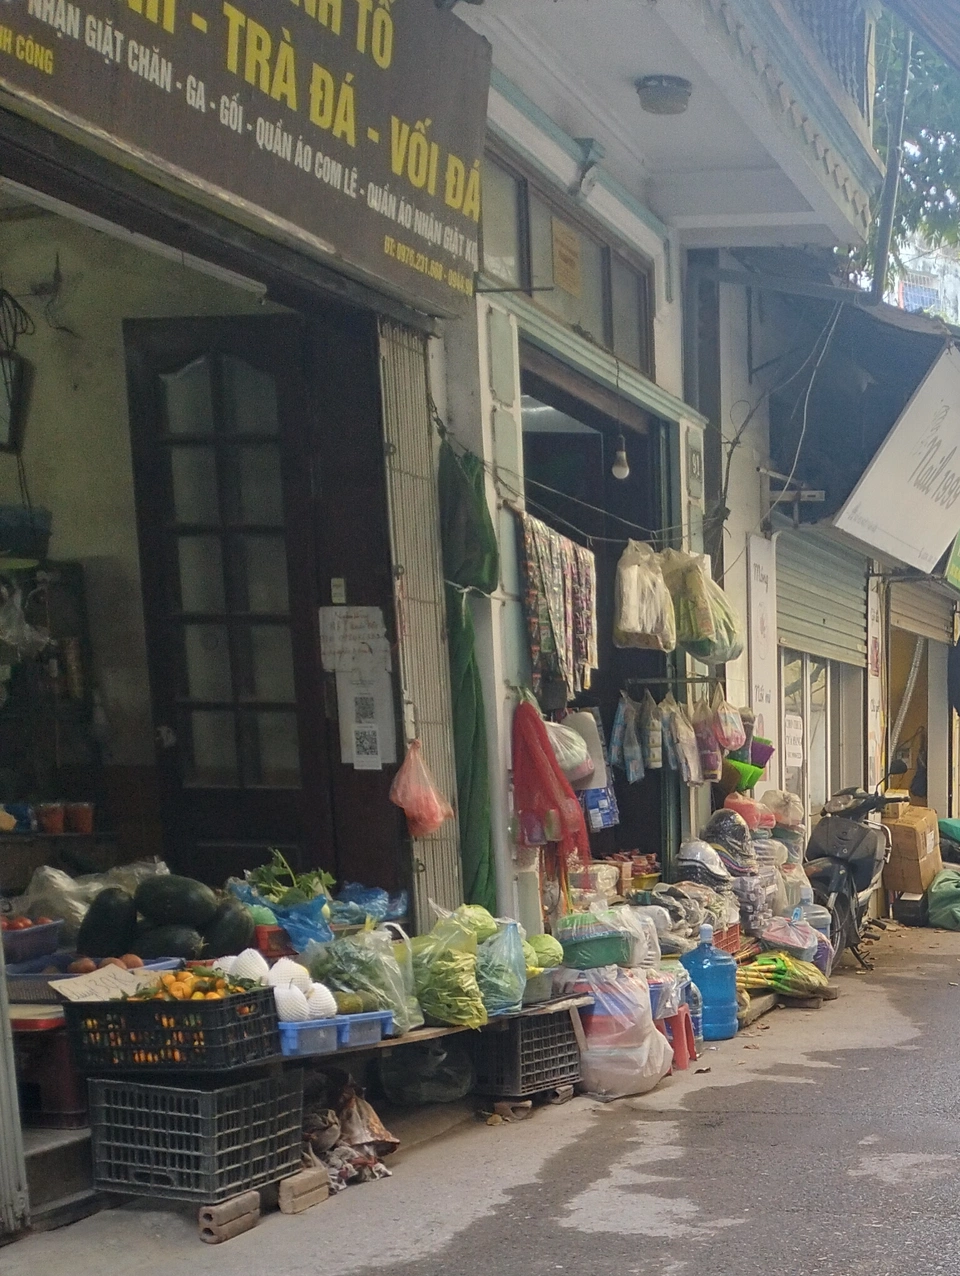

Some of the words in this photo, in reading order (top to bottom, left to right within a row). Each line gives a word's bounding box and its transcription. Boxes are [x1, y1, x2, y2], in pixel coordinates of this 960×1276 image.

[16, 35, 53, 74] CÔNG
[85, 15, 124, 64] GIẶT
[127, 40, 172, 93] CHĂN
[186, 75, 206, 113] GA
[219, 93, 243, 134] GỐI
[295, 135, 312, 172] ÁO
[314, 151, 342, 189] COM
[344, 167, 358, 198] LÊ
[223, 2, 297, 111] TRÀ
[310, 63, 355, 147] ĐÁ
[391, 115, 439, 196] VỐI
[445, 153, 480, 222] ĐÁ
